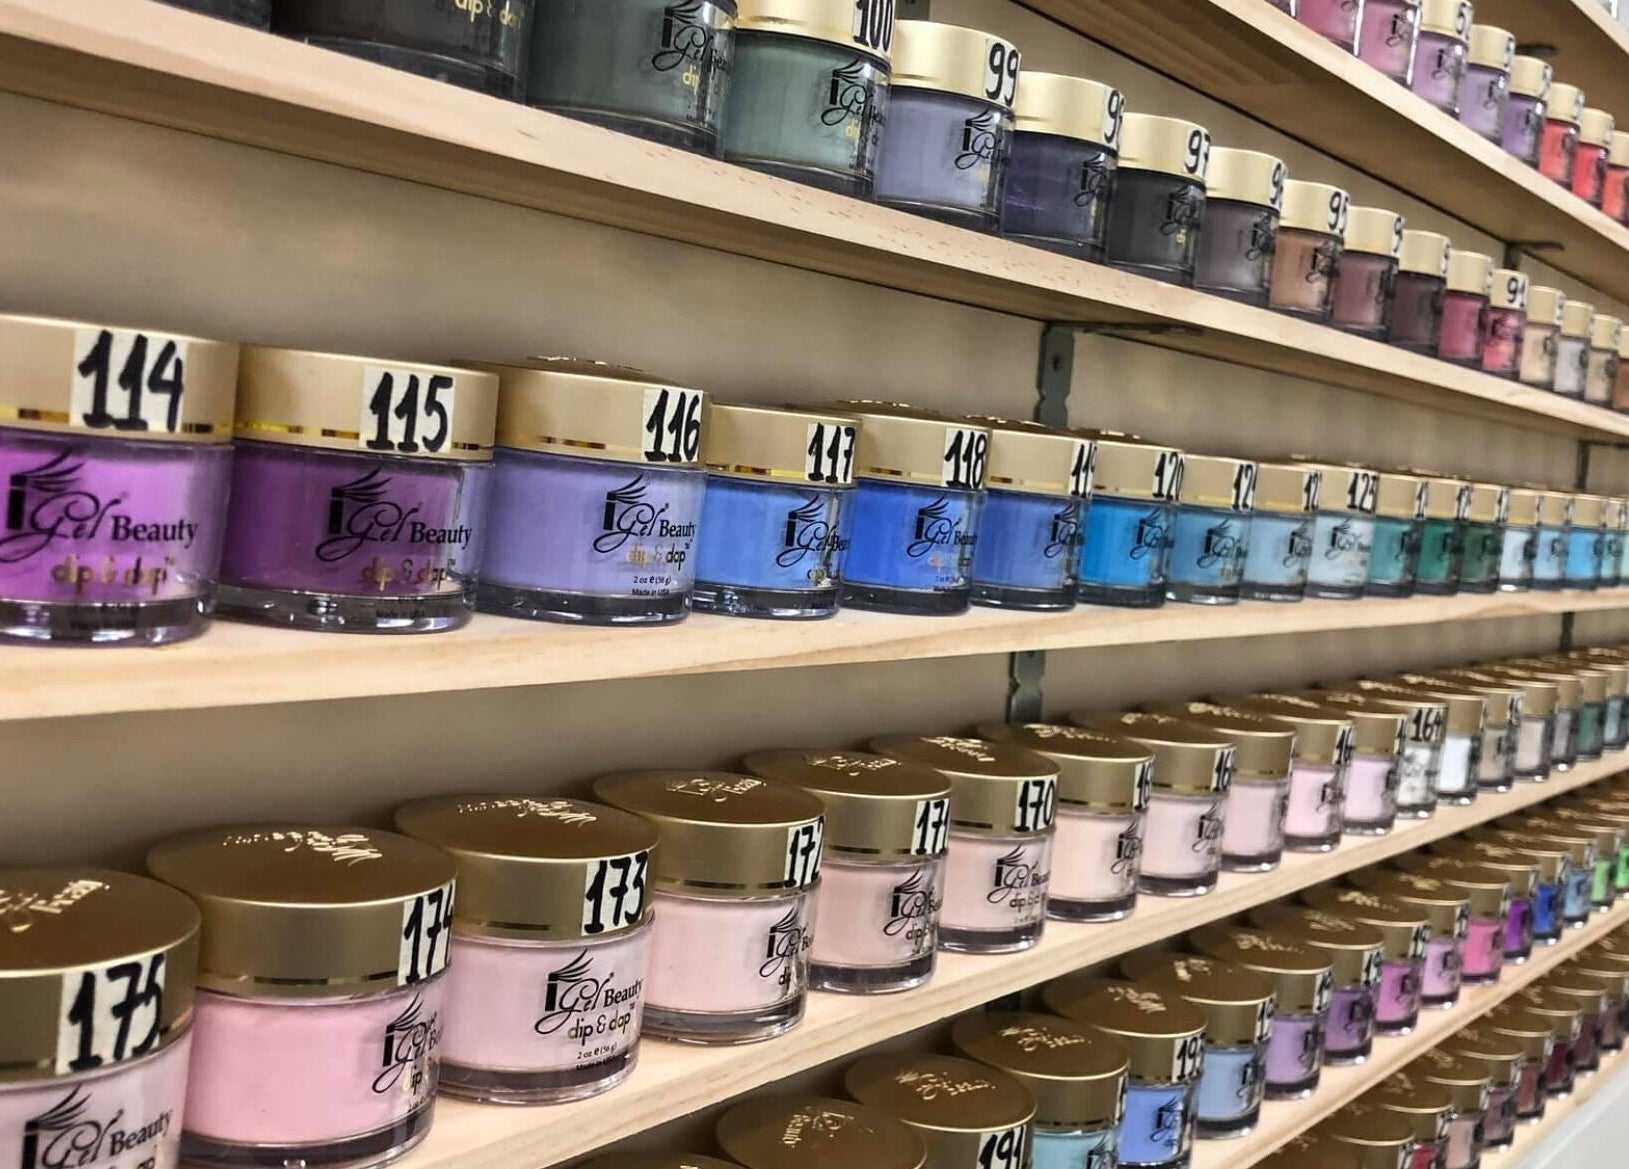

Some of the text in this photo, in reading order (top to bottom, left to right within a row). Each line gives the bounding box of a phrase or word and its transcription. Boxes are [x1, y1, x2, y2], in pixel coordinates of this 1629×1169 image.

[986, 42, 1018, 107] 99
[77, 330, 183, 432] 114
[367, 372, 453, 452] 115
[644, 389, 700, 462] 116
[807, 422, 855, 483] 117
[945, 430, 987, 488] 118
[1152, 451, 1184, 501] 120
[111, 515, 198, 549] Beauty
[410, 521, 472, 550] Beauty
[659, 519, 696, 542] Beauty
[1015, 780, 1056, 832] 170
[585, 851, 648, 934] 173
[68, 952, 165, 1070] 175
[602, 979, 643, 1008] Beauty
[567, 1017, 593, 1047] dip
[596, 1014, 606, 1034] &
[109, 1109, 173, 1156] Beauty
